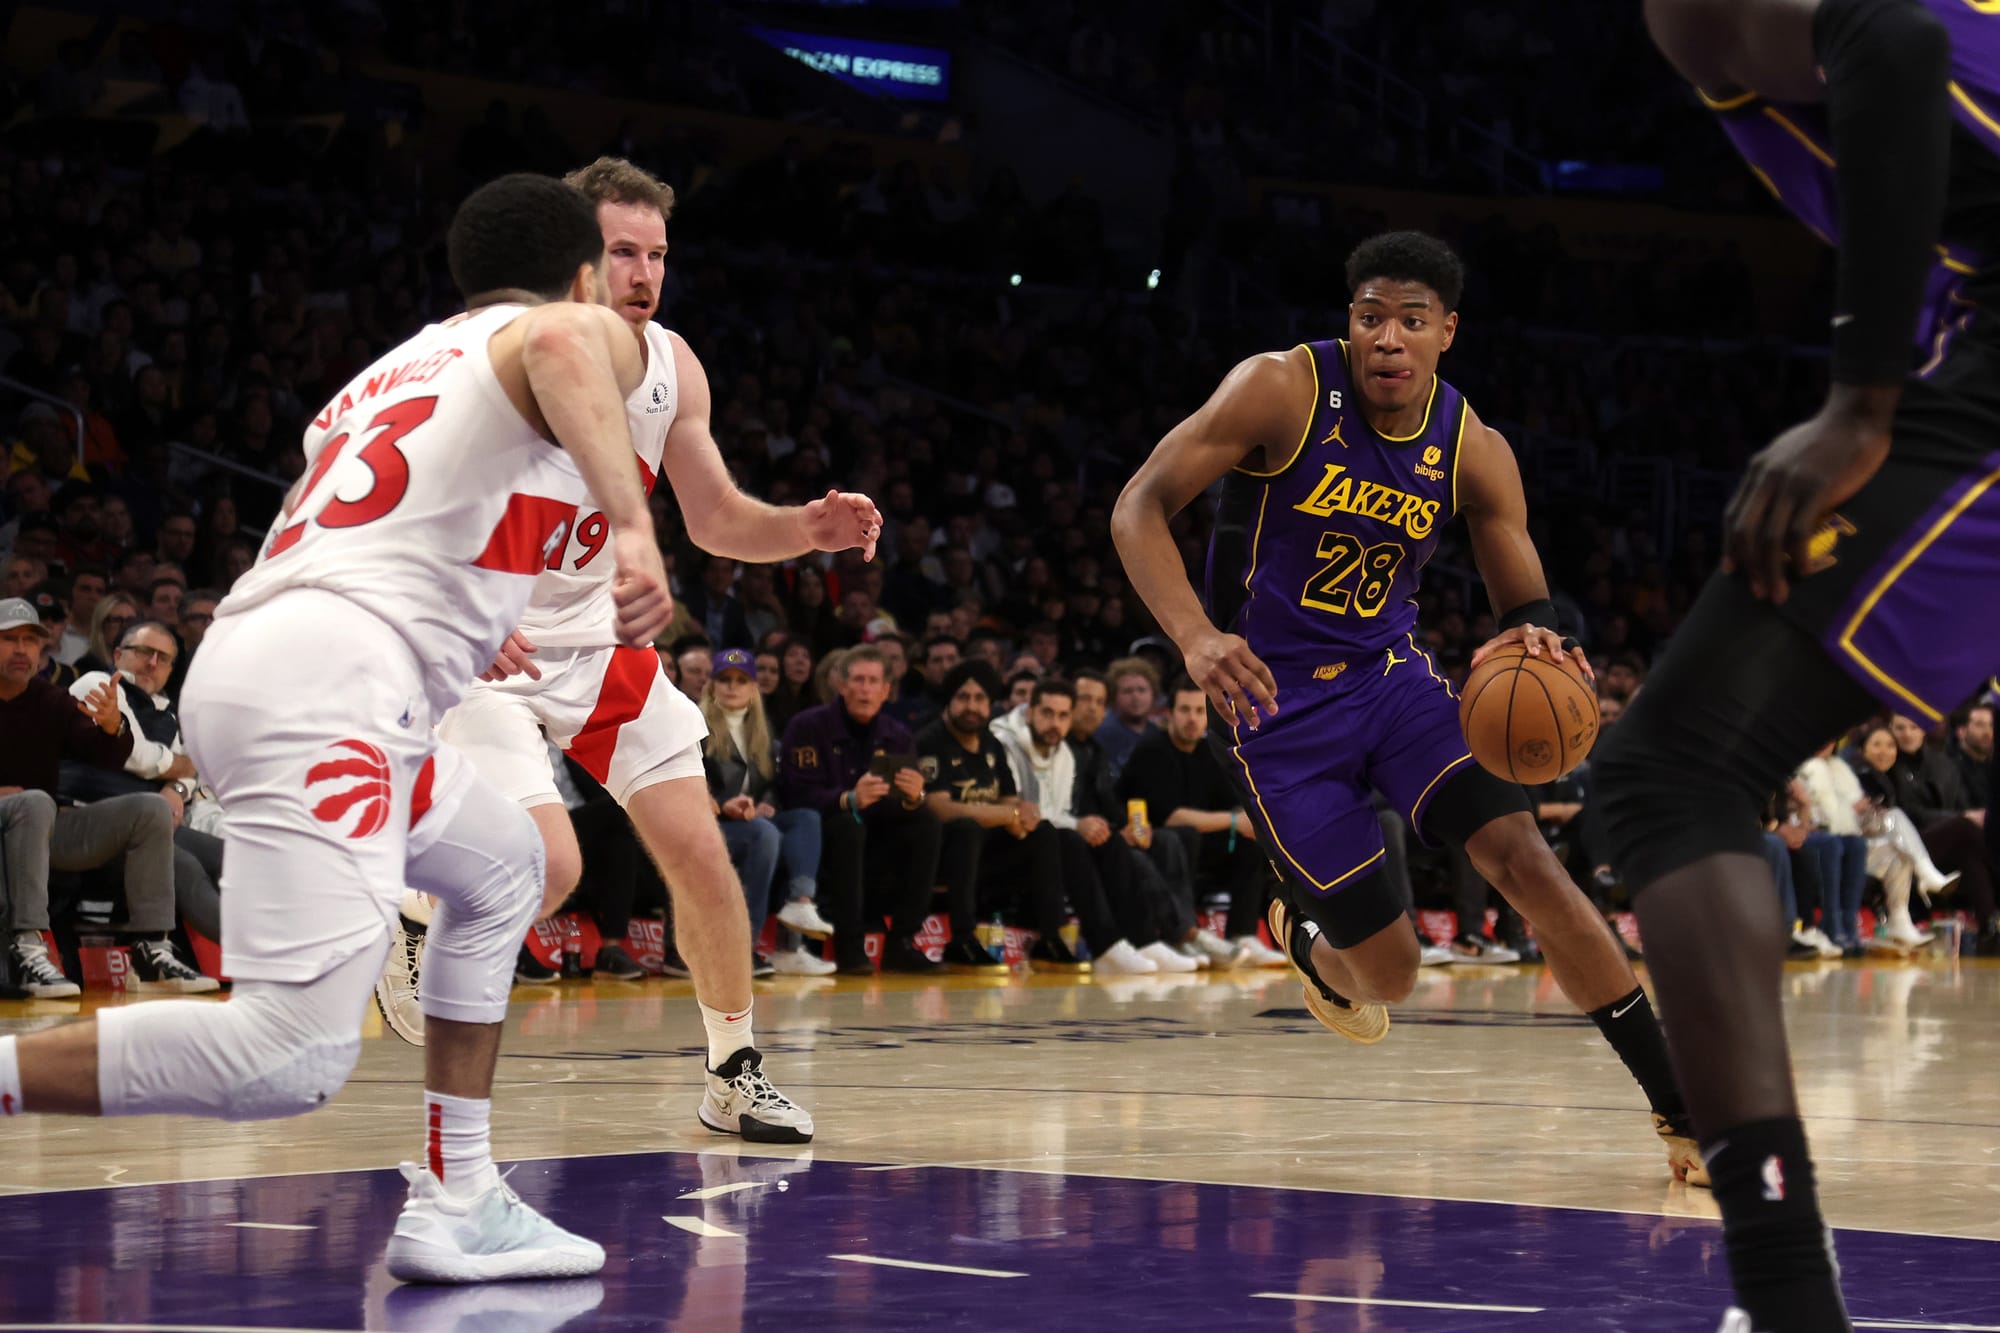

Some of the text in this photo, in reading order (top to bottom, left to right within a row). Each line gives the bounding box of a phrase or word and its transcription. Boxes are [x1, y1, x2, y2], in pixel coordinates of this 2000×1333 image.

[852, 57, 941, 85] EXPRESS
[645, 403, 670, 415] Sun Life
[1329, 390, 1342, 409] 6
[265, 395, 440, 560] 23
[1414, 463, 1445, 482] bibigo
[1292, 463, 1441, 540] LAKERS
[1300, 531, 1405, 618] 28
